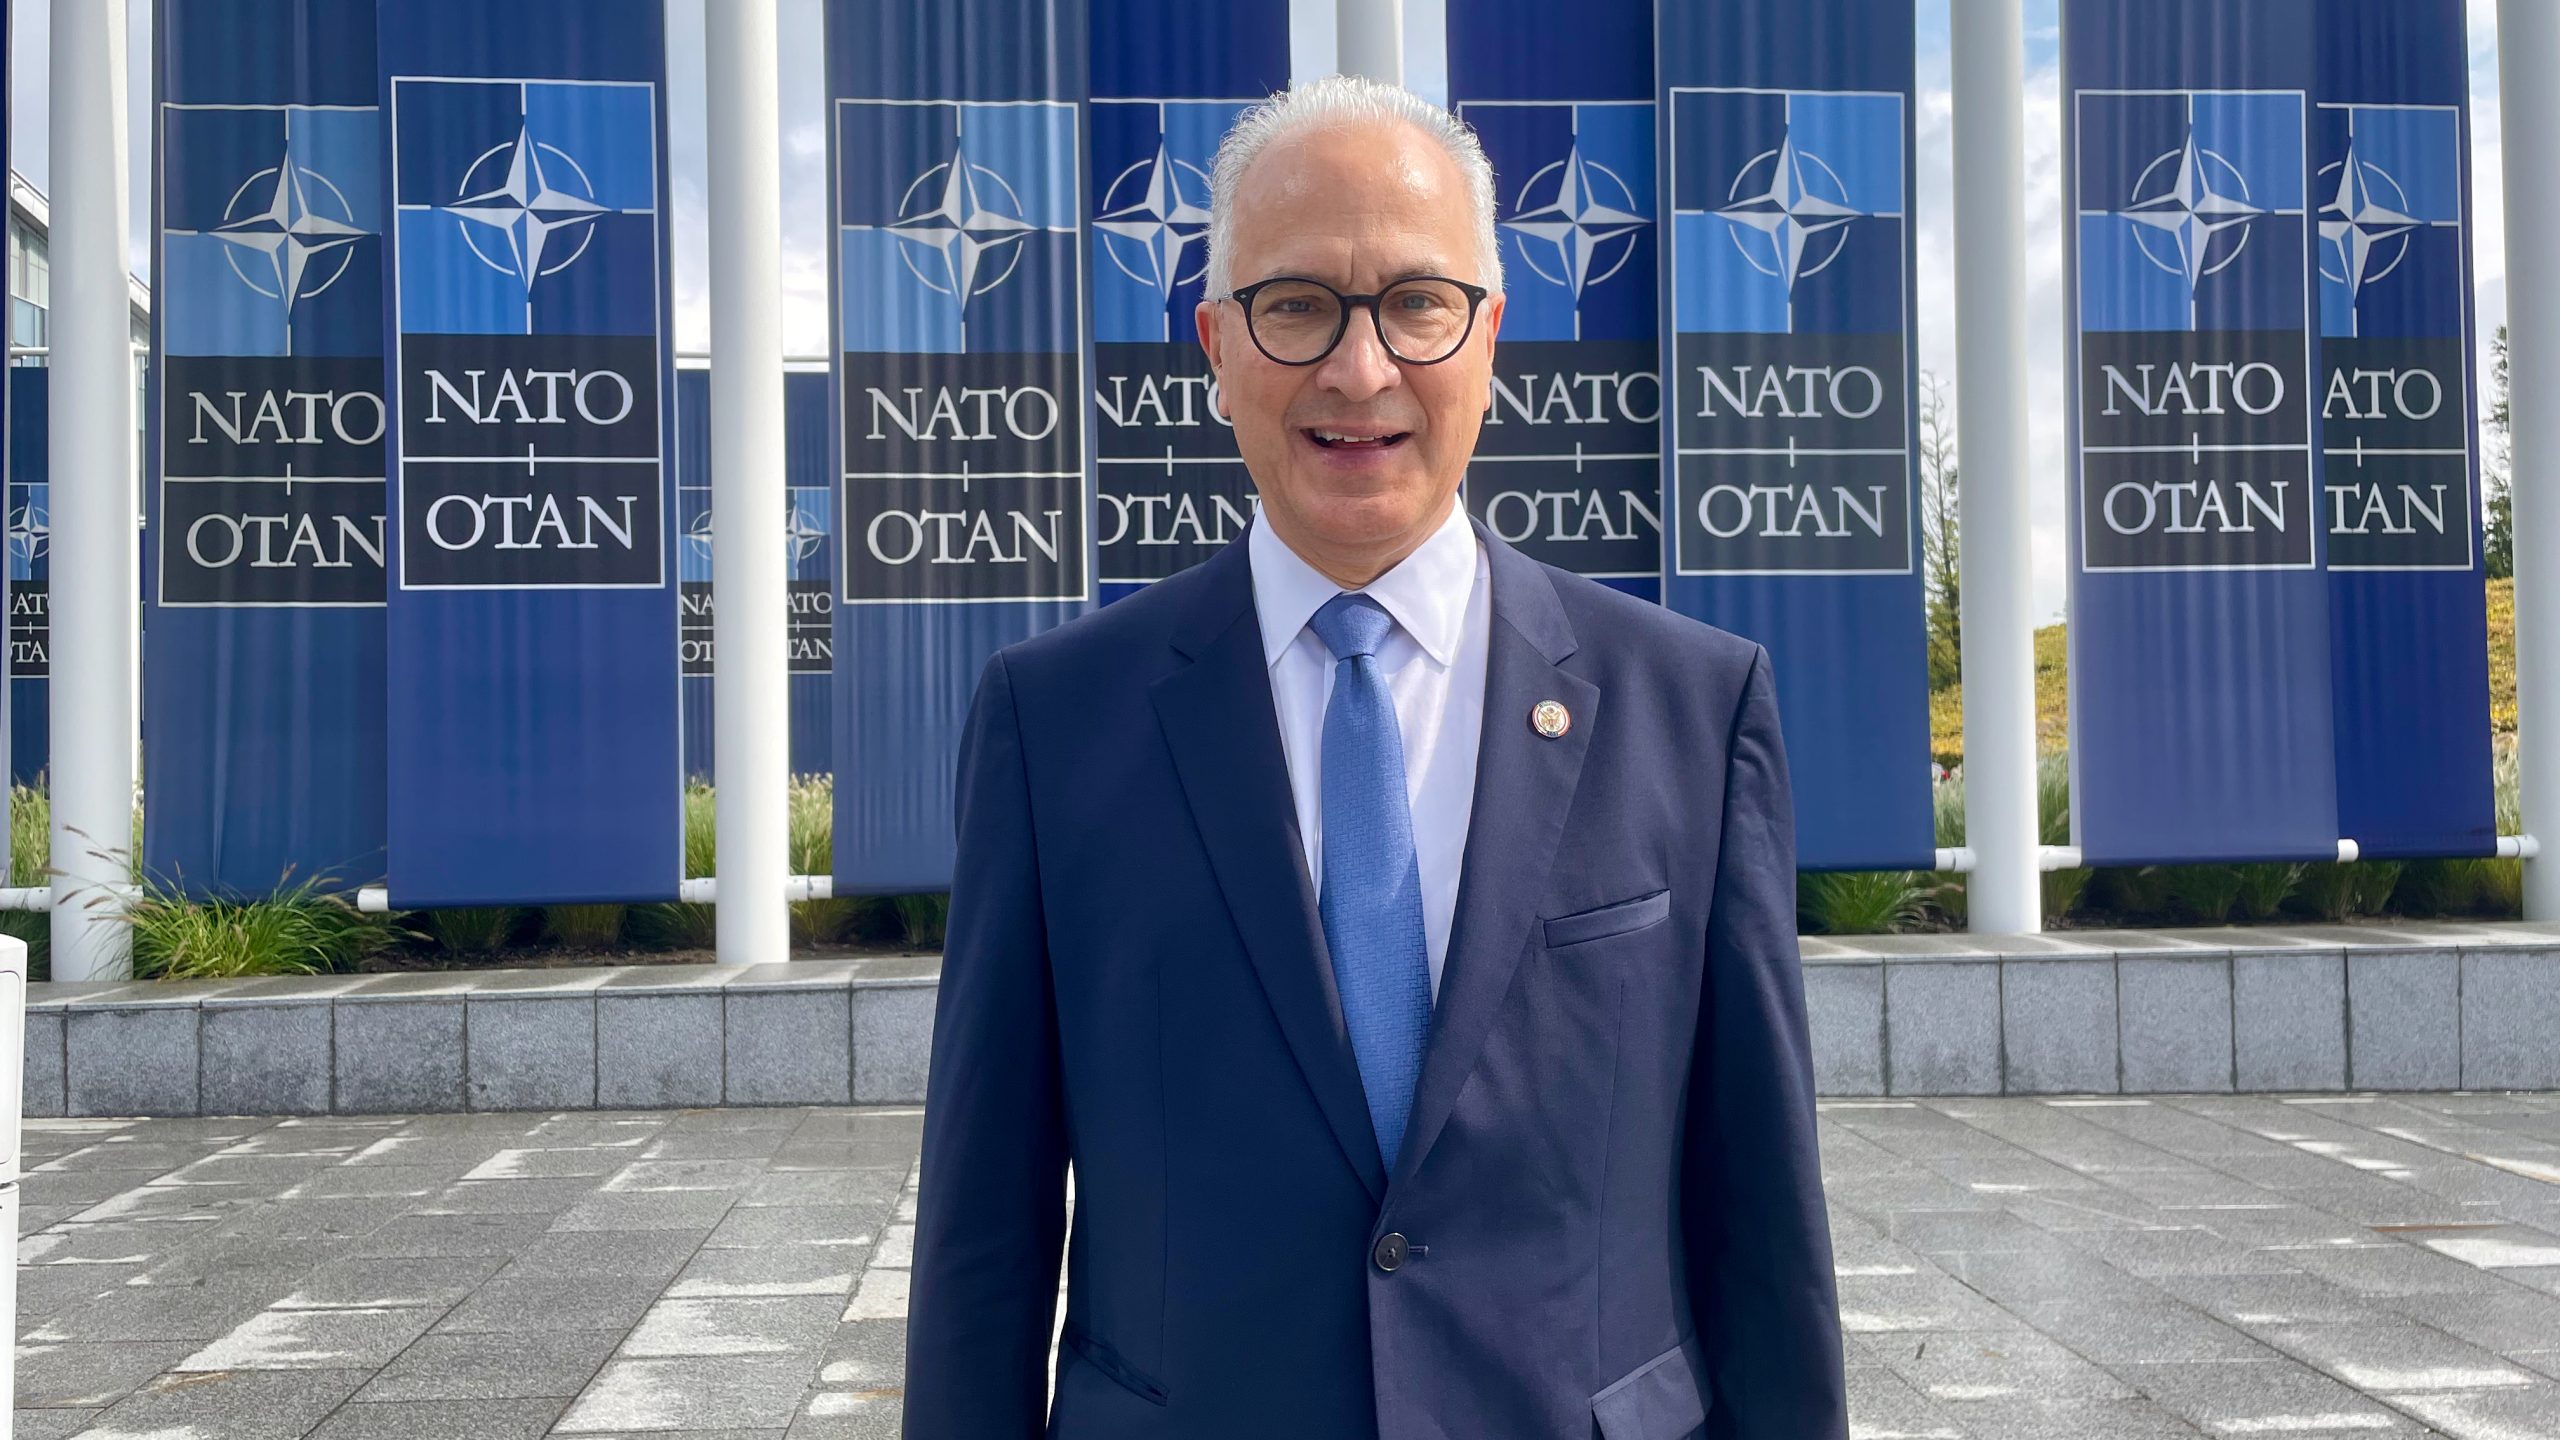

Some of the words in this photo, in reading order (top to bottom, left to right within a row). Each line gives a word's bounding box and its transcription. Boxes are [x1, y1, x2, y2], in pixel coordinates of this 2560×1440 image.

[424, 368, 633, 425] NATO
[866, 385, 1059, 441] NATO
[1484, 371, 1660, 425] NATO
[1697, 365, 1882, 418] NATO
[2101, 361, 2284, 416] NATO
[2322, 367, 2442, 420] ATO
[188, 389, 386, 445] NATO
[426, 493, 637, 550] OTAN
[1486, 488, 1661, 543] OTAN
[1698, 484, 1887, 538] OTAN
[2103, 480, 2289, 535] OTAN
[2325, 482, 2447, 534] TAN
[187, 513, 387, 568] OTAN
[867, 509, 1062, 564] OTAN
[10, 592, 49, 615] AT
[681, 593, 714, 616] NA
[787, 592, 832, 614] ATO
[10, 640, 49, 663] TA
[682, 640, 714, 662] OT
[787, 637, 832, 660] TAN
